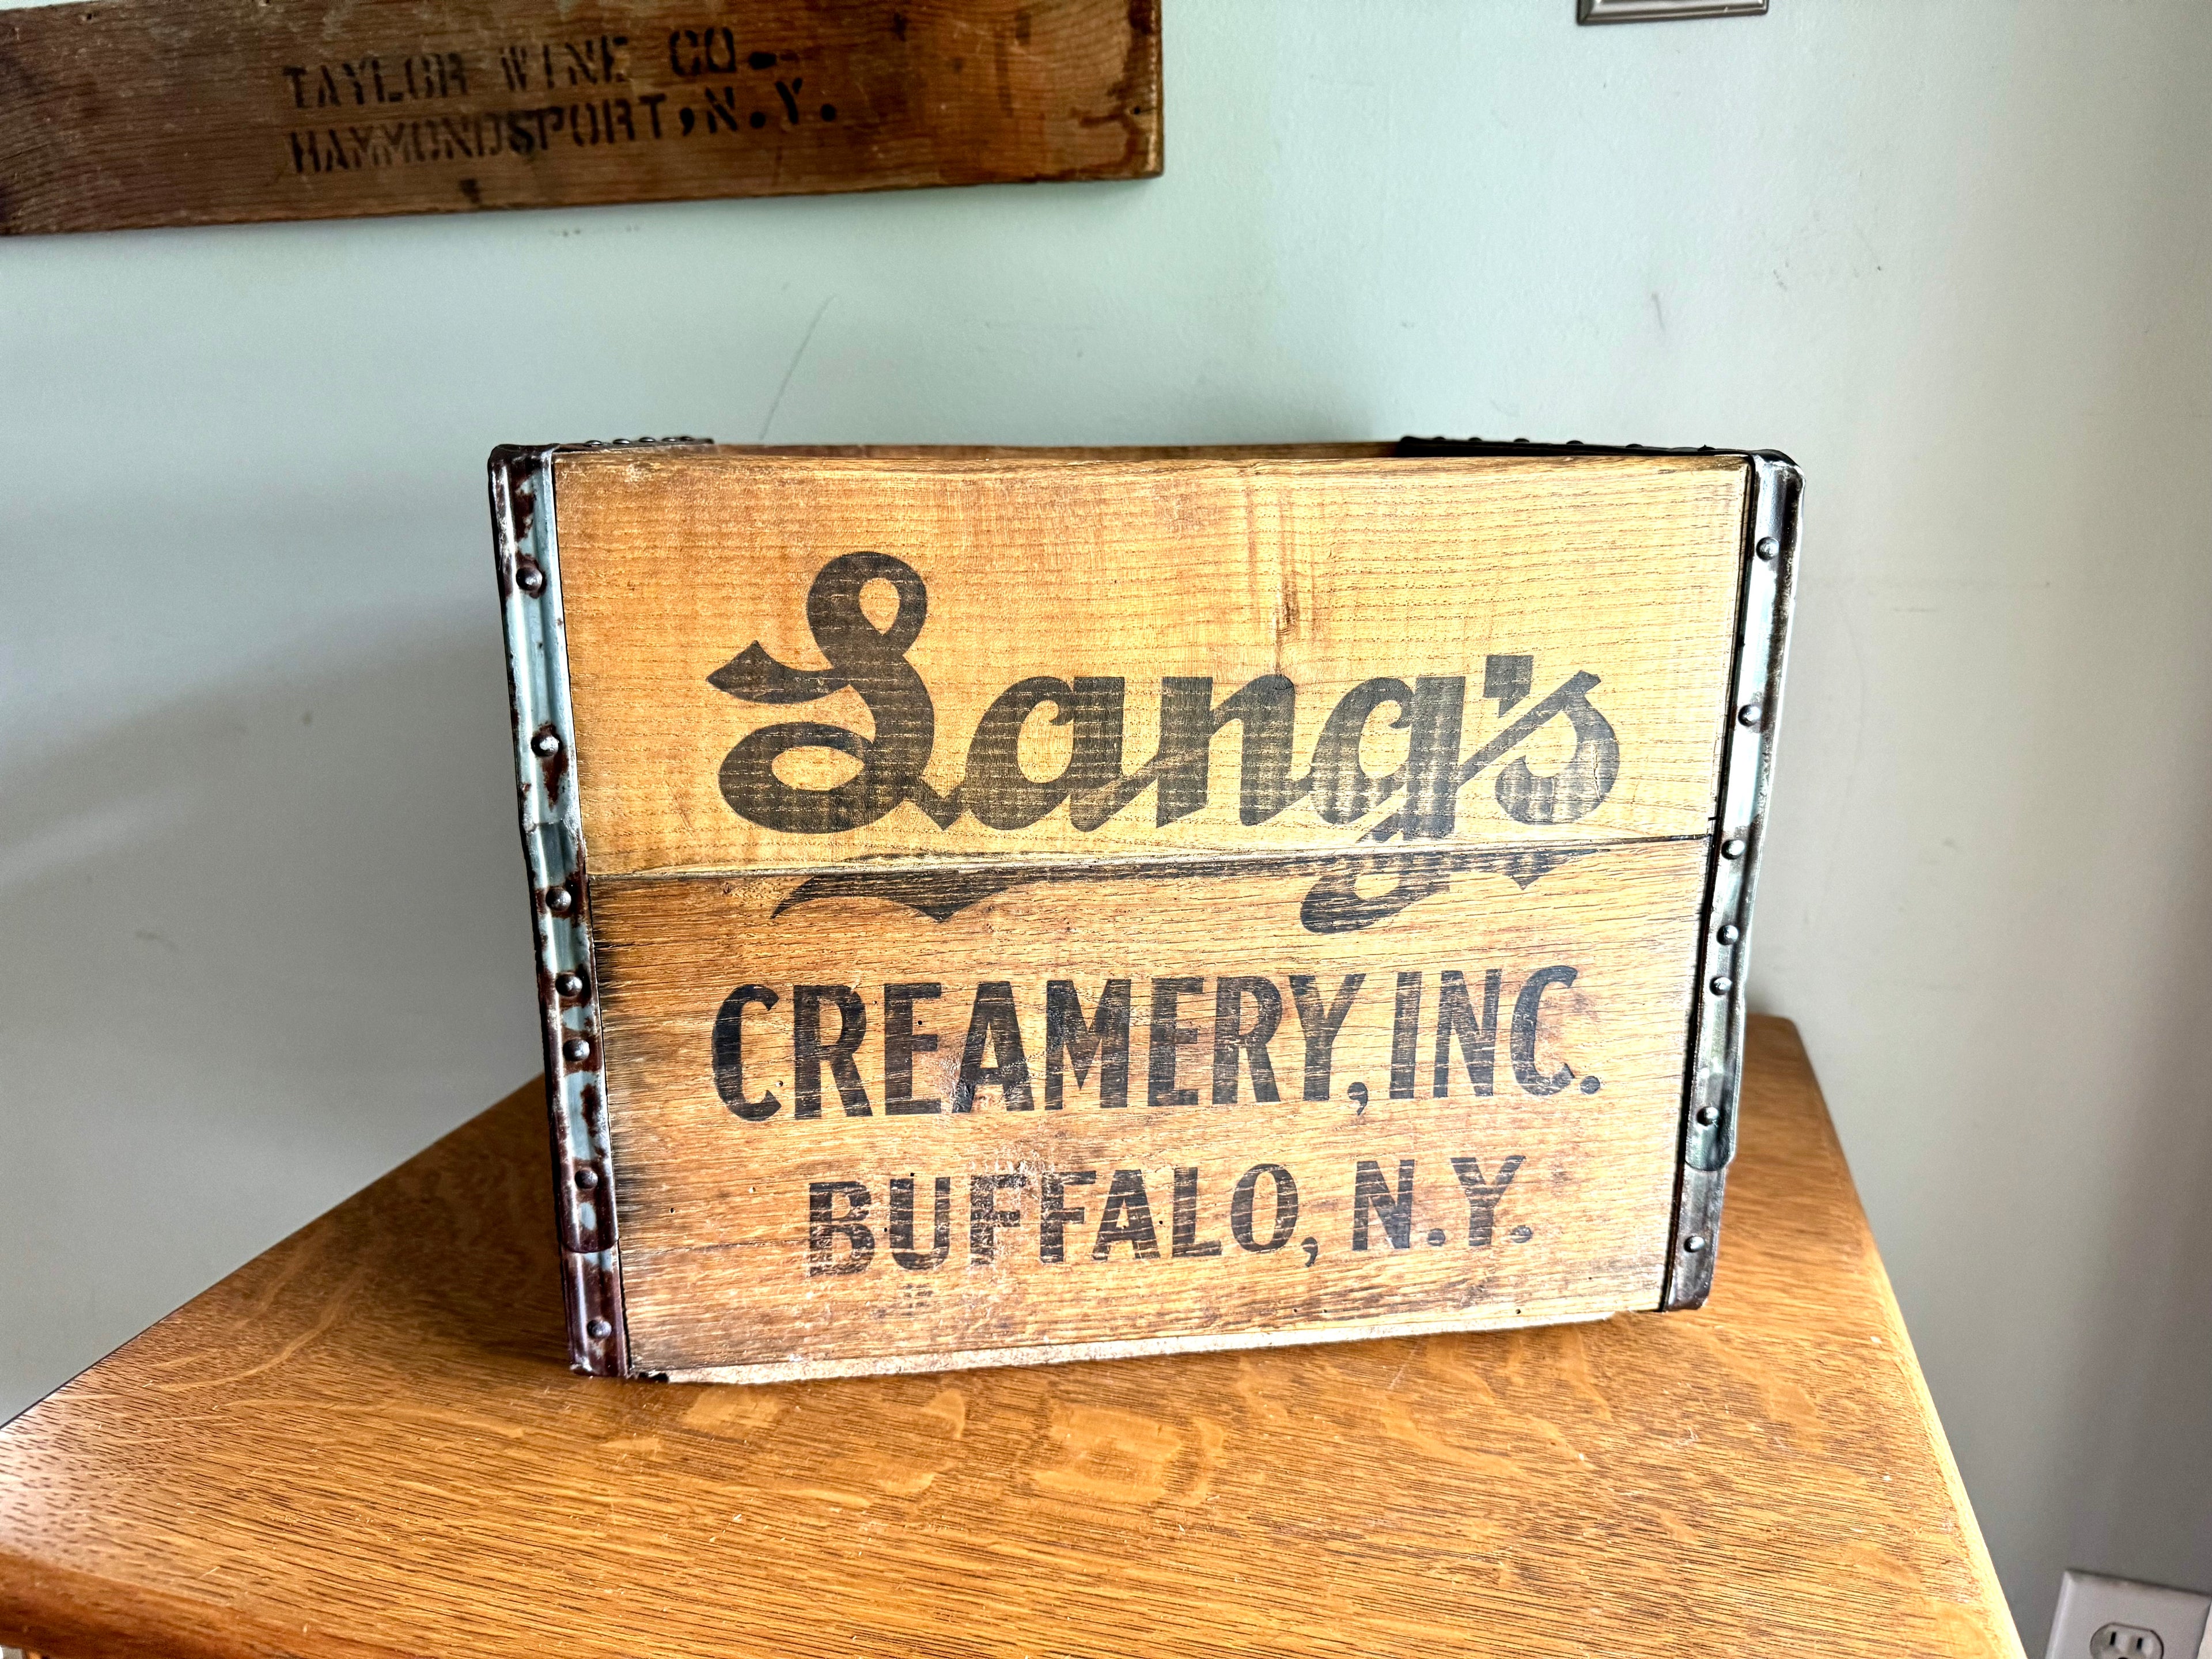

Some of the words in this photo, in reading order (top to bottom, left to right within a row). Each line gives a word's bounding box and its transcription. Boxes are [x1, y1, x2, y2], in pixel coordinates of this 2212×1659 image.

[282, 50, 468, 109] TAYLOR
[499, 35, 630, 93] WINE
[1387, 964, 1603, 1100] INC.
[808, 1161, 1319, 1278] BUFFALO,
[1351, 1154, 1534, 1252] N.Y.
